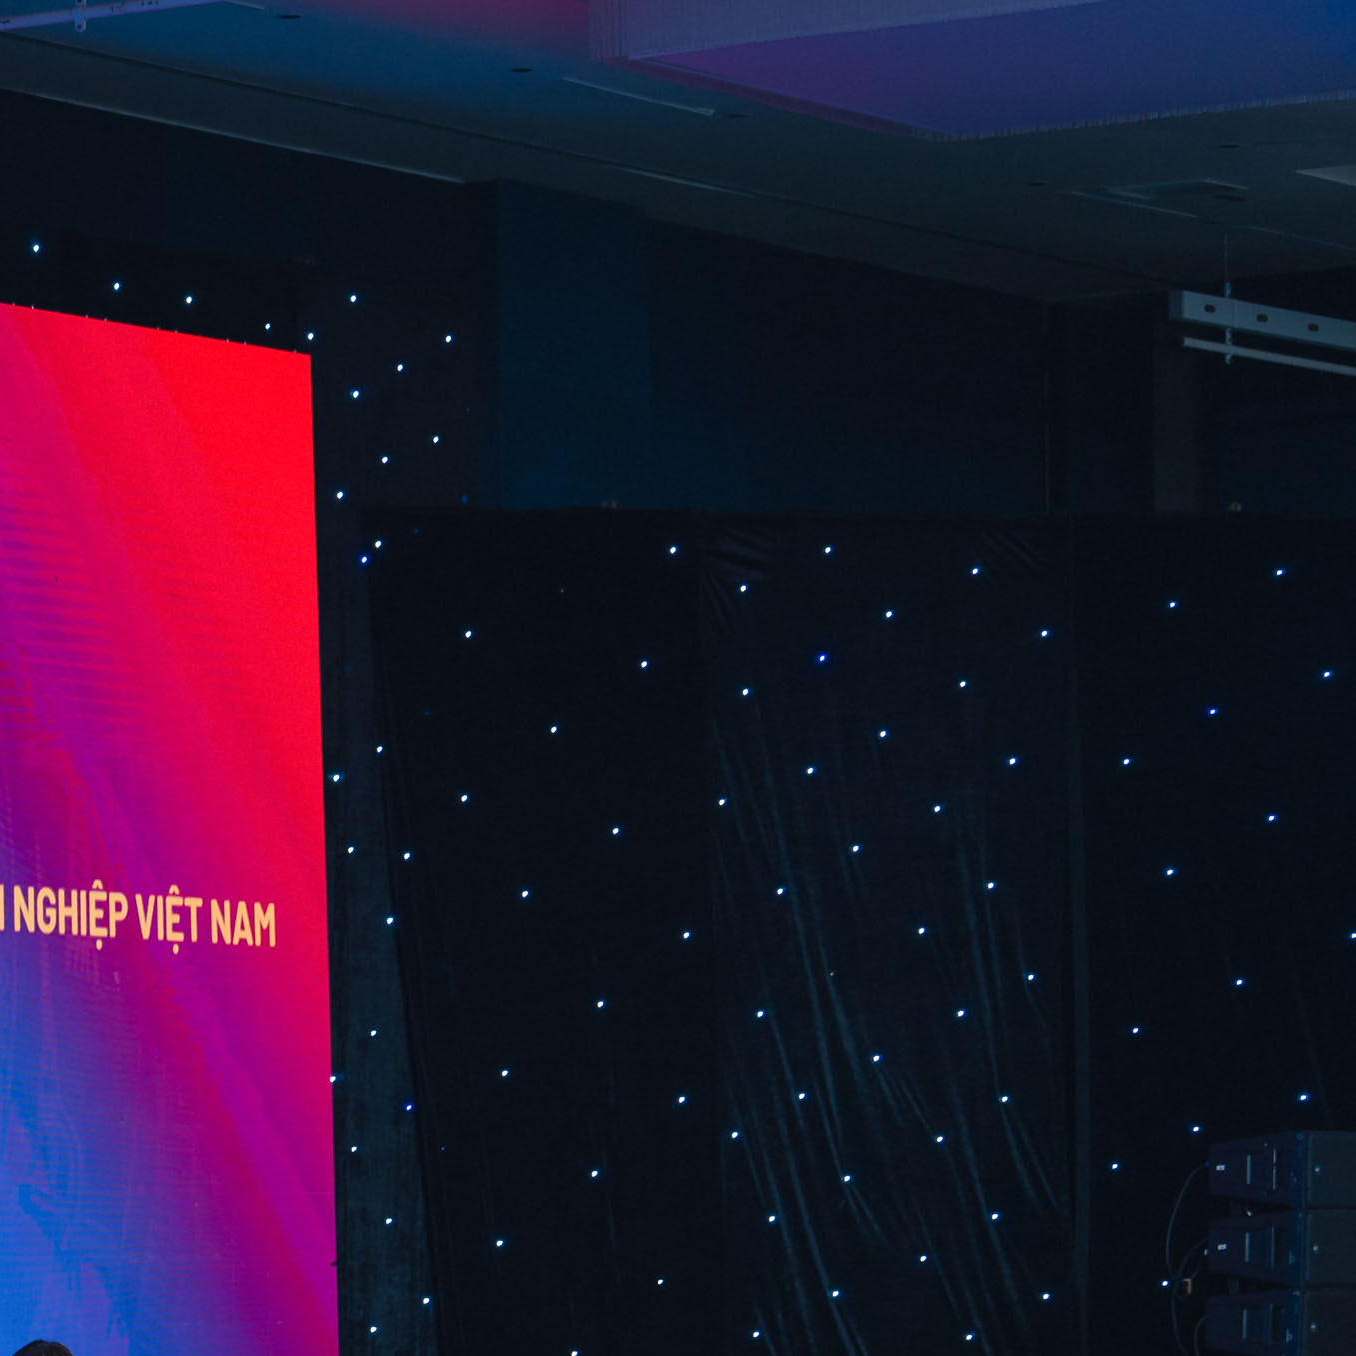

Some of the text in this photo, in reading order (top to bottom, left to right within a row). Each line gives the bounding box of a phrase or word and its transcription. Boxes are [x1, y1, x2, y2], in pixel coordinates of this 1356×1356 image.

[13, 880, 129, 950] NGHIỆP
[135, 885, 204, 954] VIỆT
[211, 899, 277, 948] NAM
